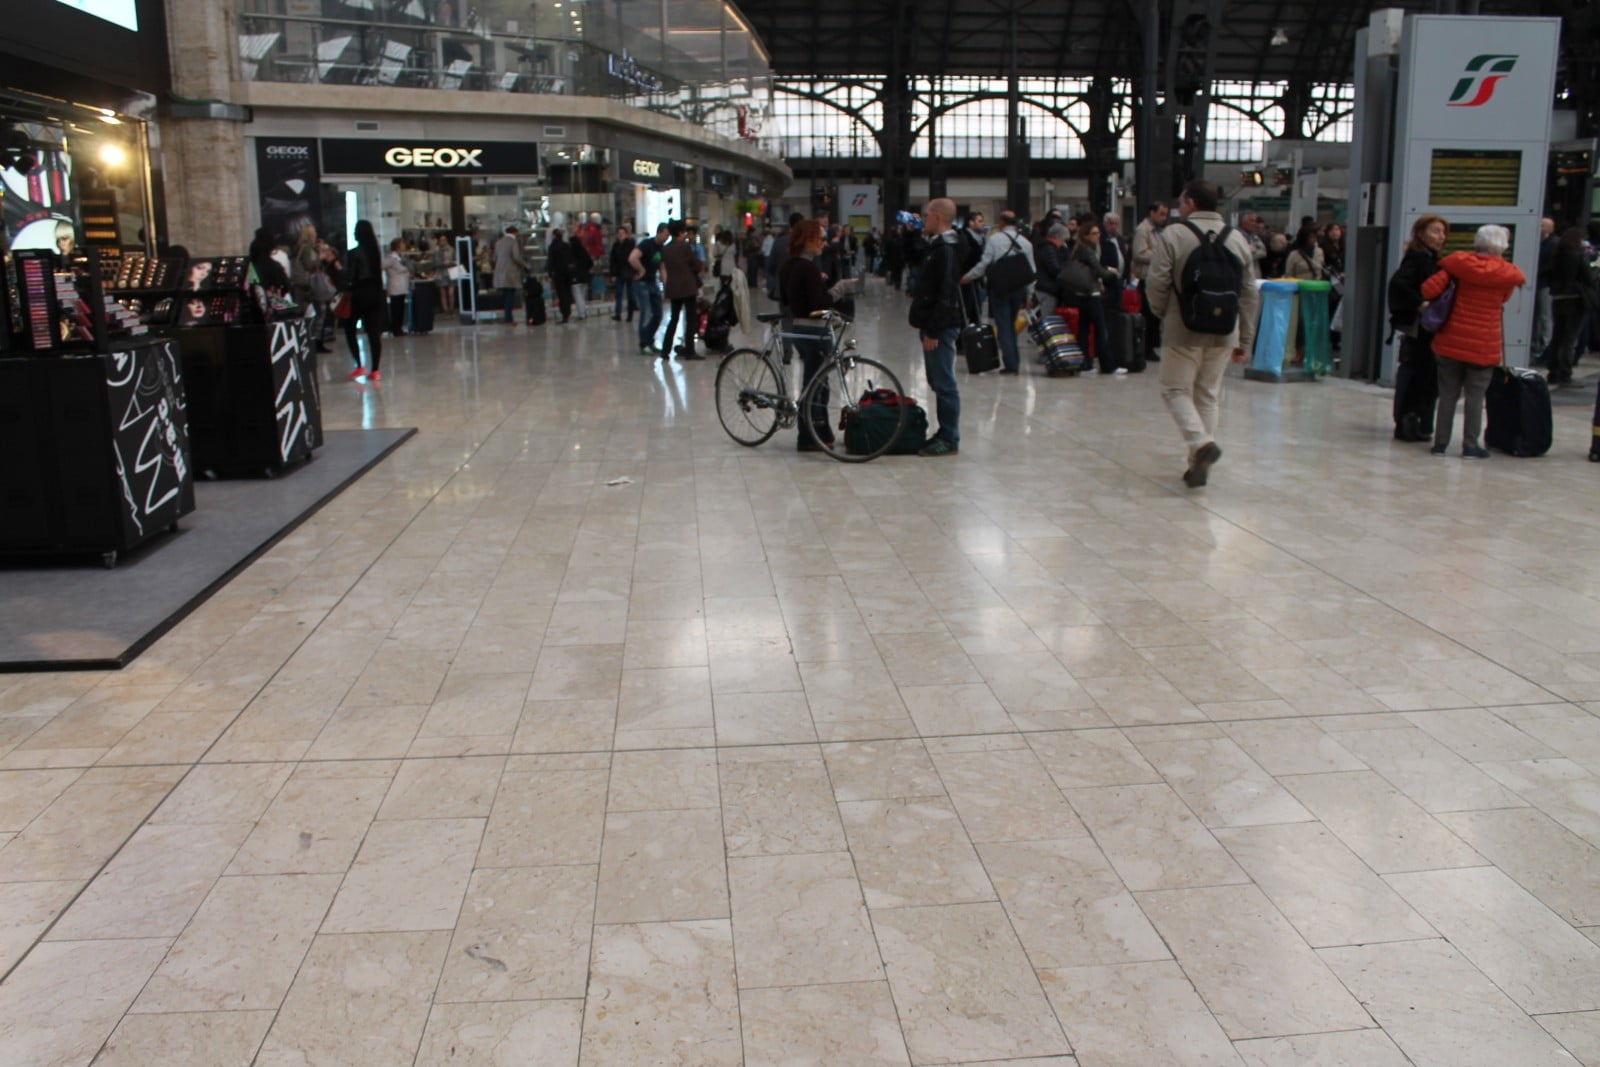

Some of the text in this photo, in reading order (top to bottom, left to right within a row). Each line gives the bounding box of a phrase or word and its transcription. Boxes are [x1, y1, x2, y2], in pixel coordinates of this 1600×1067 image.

[266, 145, 309, 155] GEOX
[385, 147, 483, 168] GEOX
[633, 159, 660, 178] GEOX
